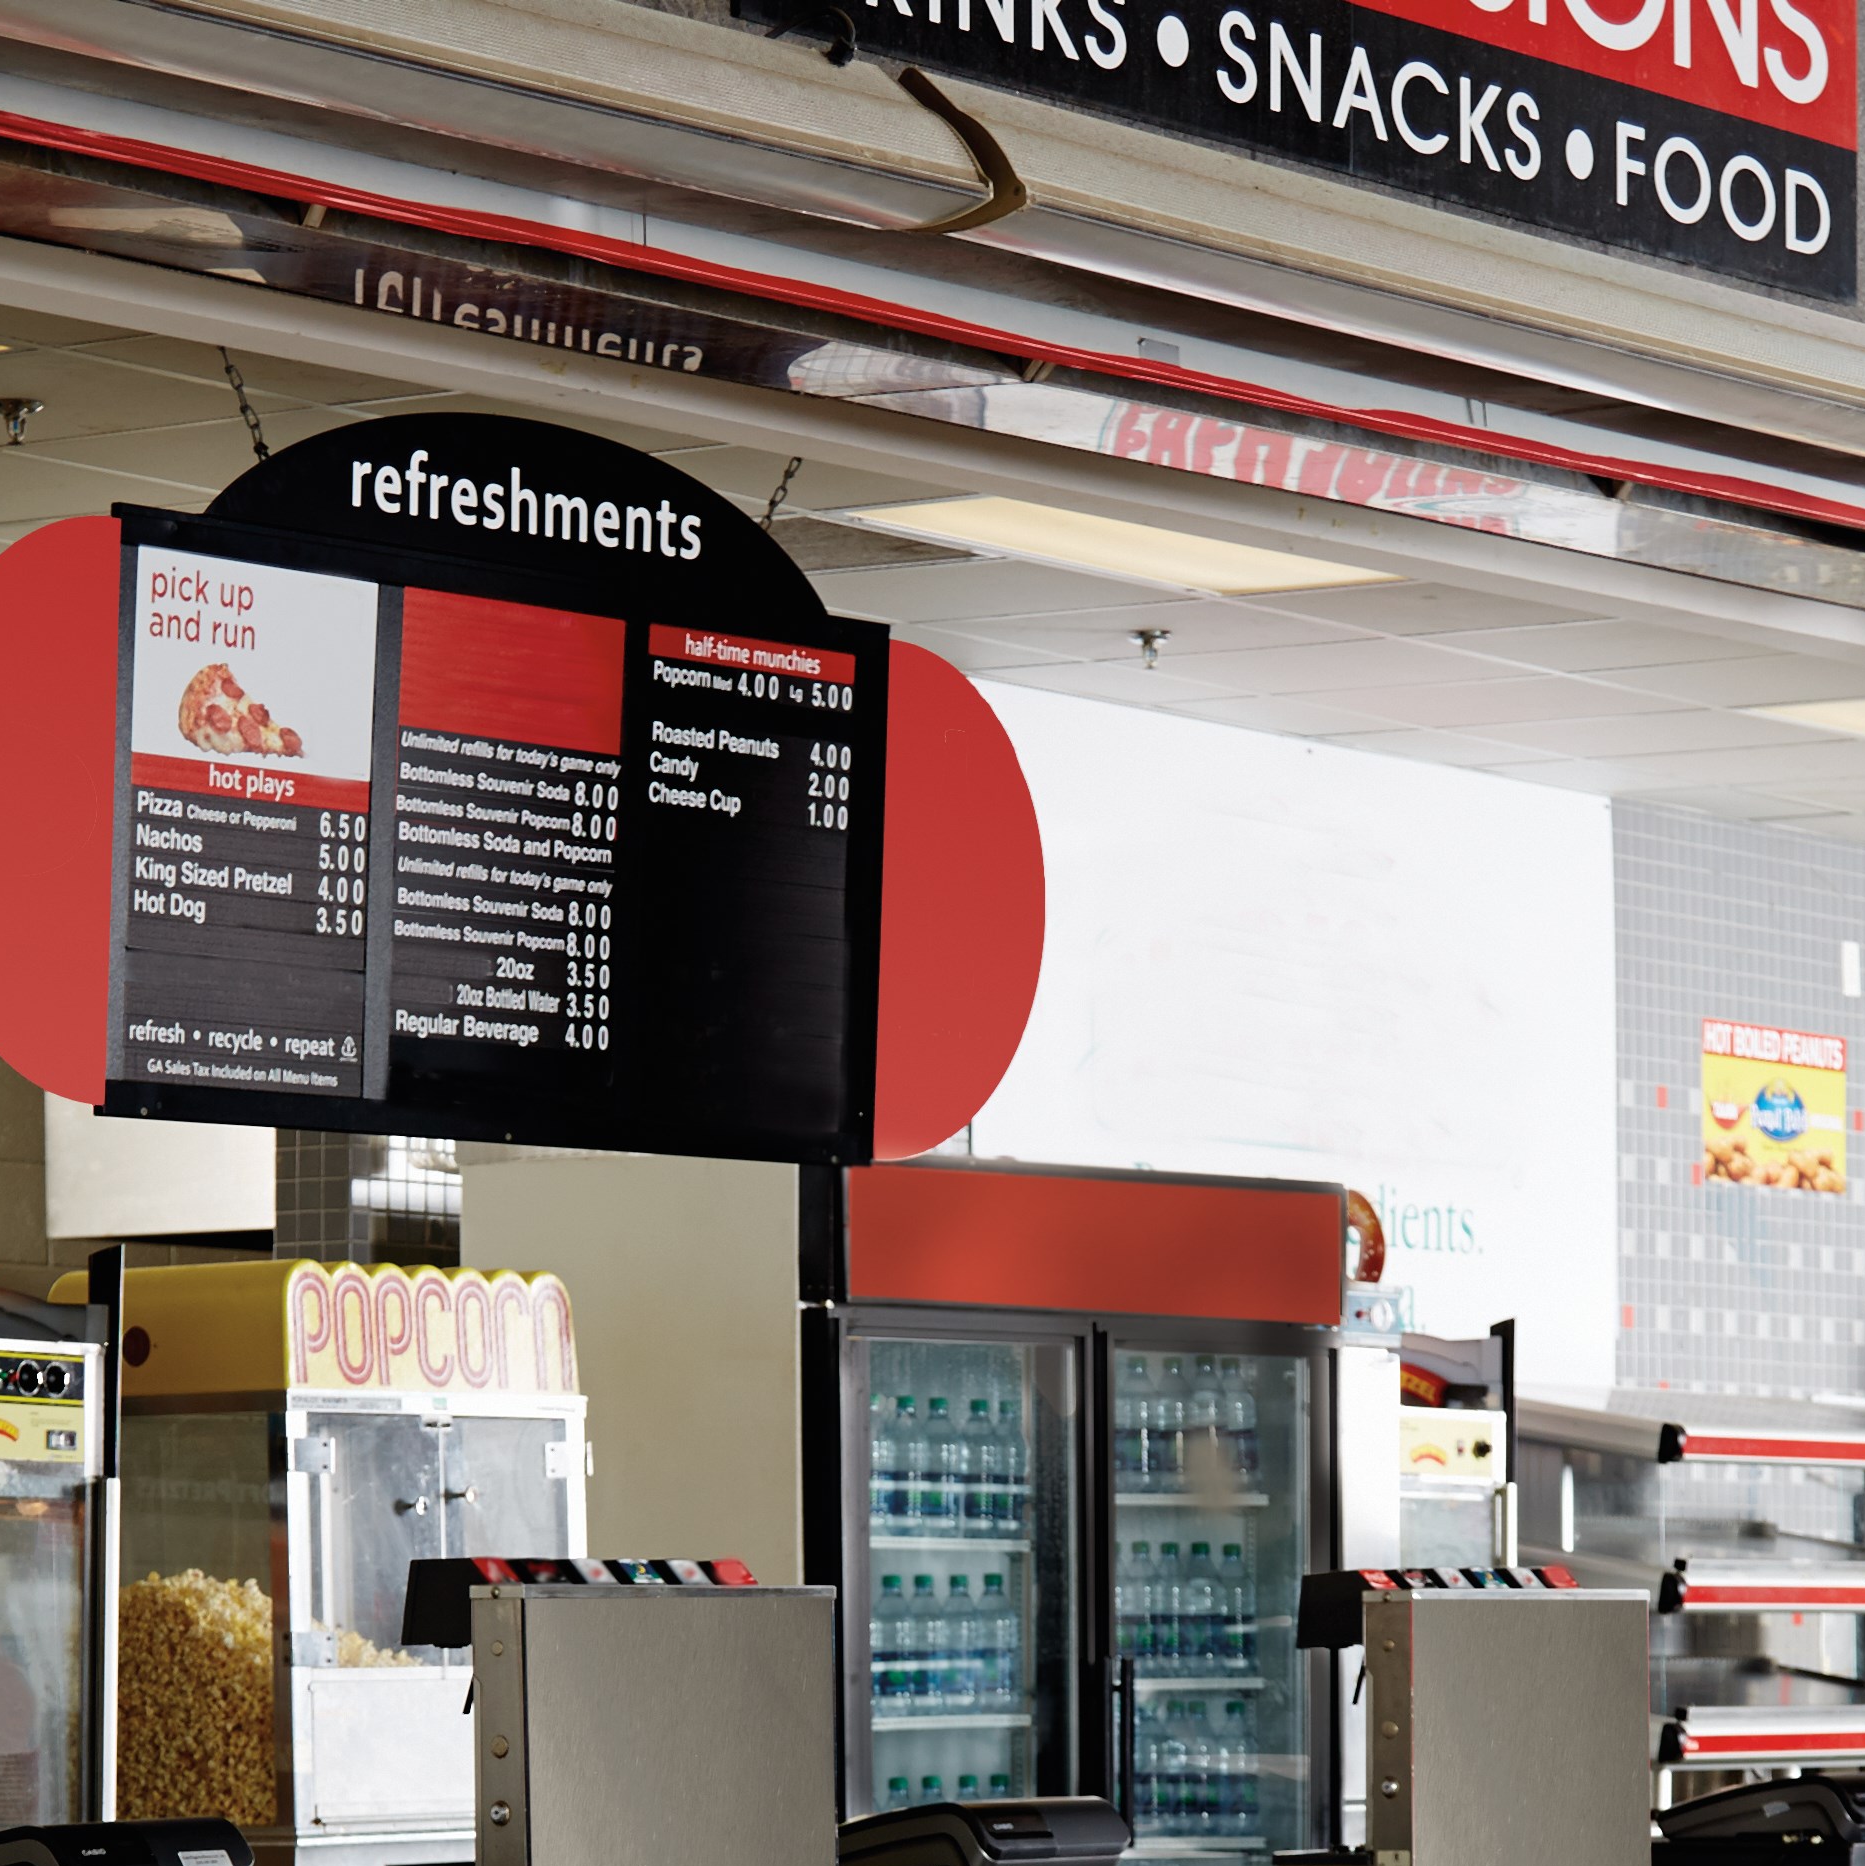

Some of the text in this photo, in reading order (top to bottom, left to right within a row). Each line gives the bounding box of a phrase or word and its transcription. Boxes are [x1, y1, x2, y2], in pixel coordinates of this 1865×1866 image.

[1216, 10, 1542, 183] SNACKS
[1614, 120, 1832, 256] FOOD
[352, 450, 702, 560] refreshments
[152, 566, 253, 615] pick up
[150, 610, 255, 650] and run
[685, 633, 821, 675] half-time munchies
[653, 660, 710, 688] Popcorn
[737, 672, 779, 700] 4.00
[790, 685, 803, 703] Lg
[811, 683, 853, 711] 5.00
[401, 731, 621, 780] Unlimited refills for today's game only
[652, 721, 851, 770] Roasted Peanuts 4.00
[209, 763, 295, 801] hot plays
[400, 762, 618, 811] Bottomless Souvenir Soda 8.00
[650, 751, 849, 801] Candy 2.00
[138, 790, 365, 842] Pizza Cheese or Pepperoni 6.50
[396, 794, 617, 841] Bottomless Souvenir Popcorn 8.00
[648, 782, 848, 830] Cheese Cup 1.00
[136, 823, 365, 873] Nachos 5.00
[398, 821, 612, 864] Bottomless Soda and Popcorn
[135, 856, 364, 905] King Sized Pretzel 4.00
[398, 856, 613, 898] Unlimited refills for today's game only
[134, 889, 363, 935] Hot Dog 3.50
[397, 887, 611, 930] Bottomless Souvenir Soda 8.00
[394, 920, 610, 960] Bottomless Souvenir Popcorn 8.00
[496, 956, 610, 990] 20oz 3.50
[457, 983, 609, 1020] 20oz Bottled Water 3.50
[129, 1019, 335, 1060] refresh recycle repeat
[396, 1009, 609, 1050] Regular Beverage 4.00
[1703, 1021, 1843, 1069] HOT BOILED PEANUTS
[147, 1058, 163, 1074] GA
[165, 1060, 190, 1076] Sales
[193, 1062, 210, 1077] Tax
[212, 1065, 252, 1081] Included
[254, 1070, 266, 1081] on
[268, 1067, 280, 1082] All
[283, 1070, 309, 1085] Menu
